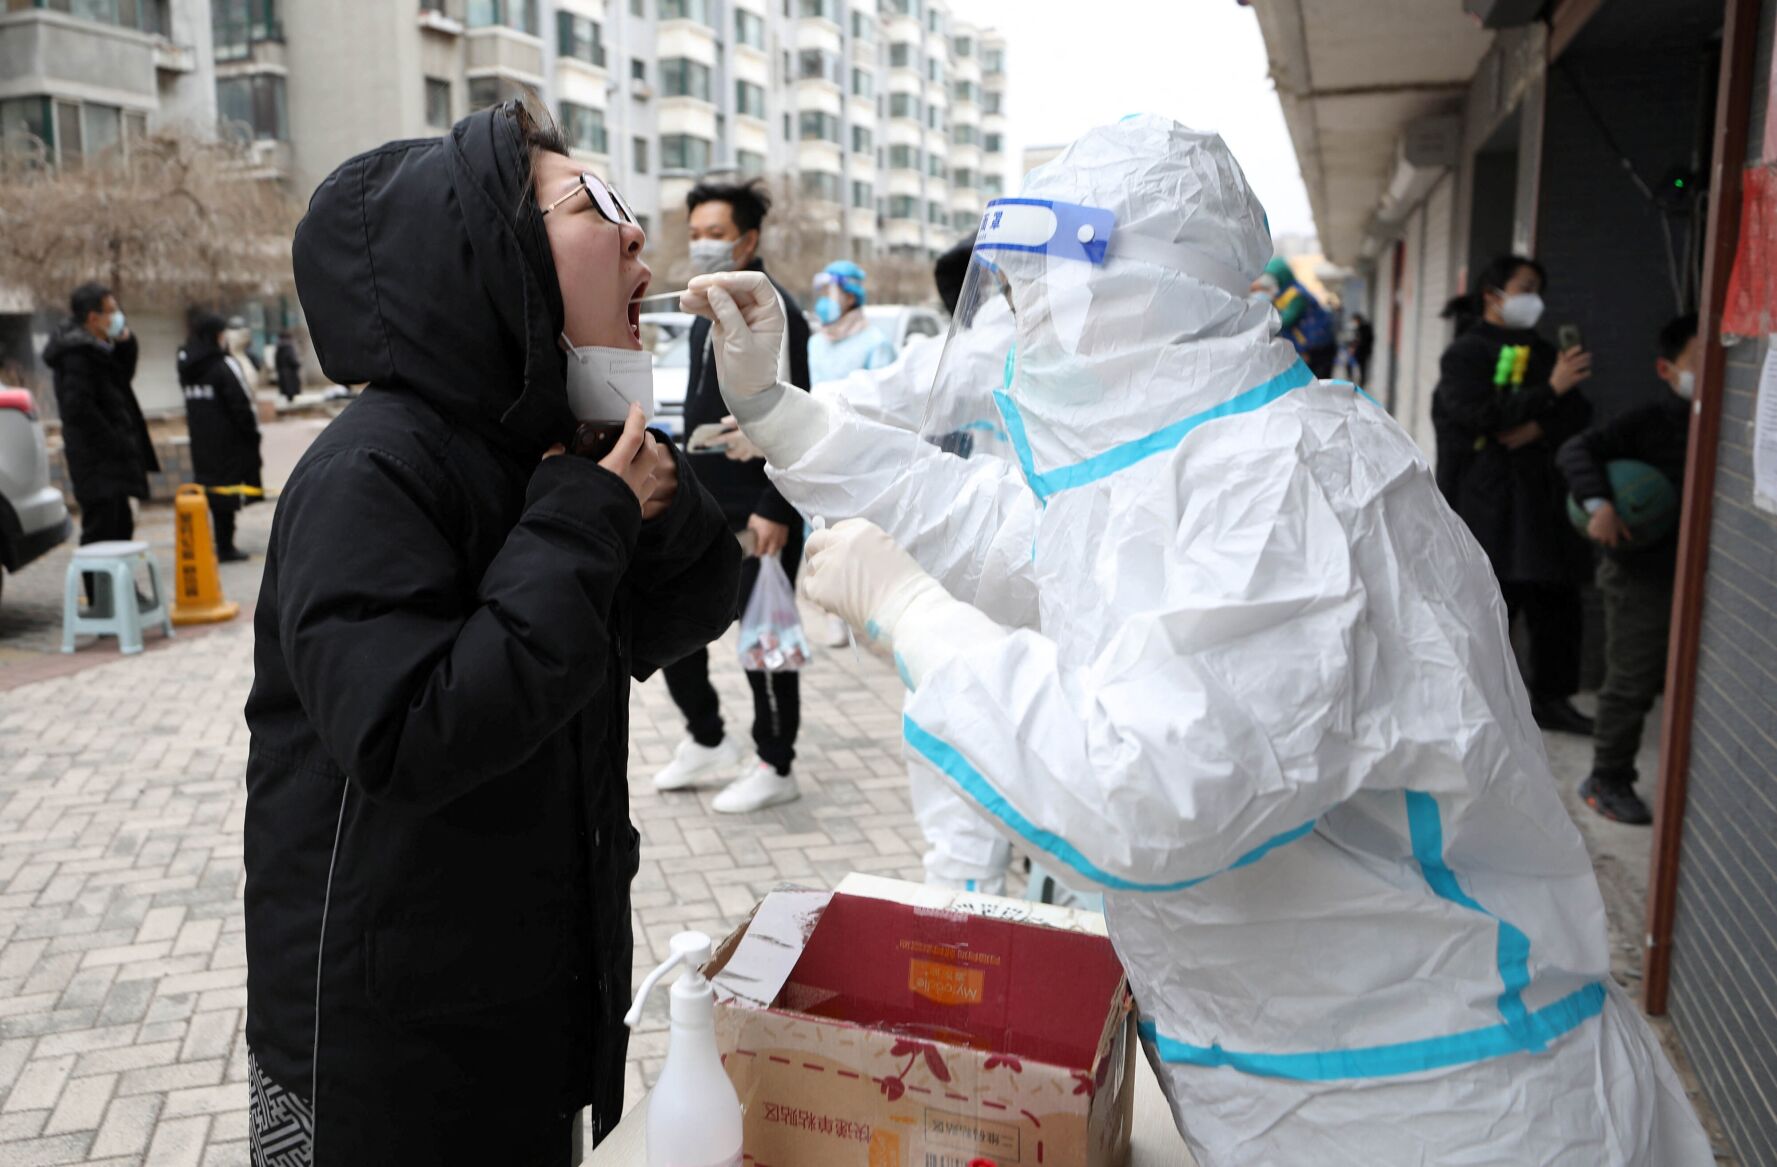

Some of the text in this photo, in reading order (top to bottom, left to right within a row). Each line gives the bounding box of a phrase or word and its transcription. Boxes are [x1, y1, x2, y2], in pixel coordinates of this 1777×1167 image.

[762, 1102, 872, 1143] 快递单粘贴区
